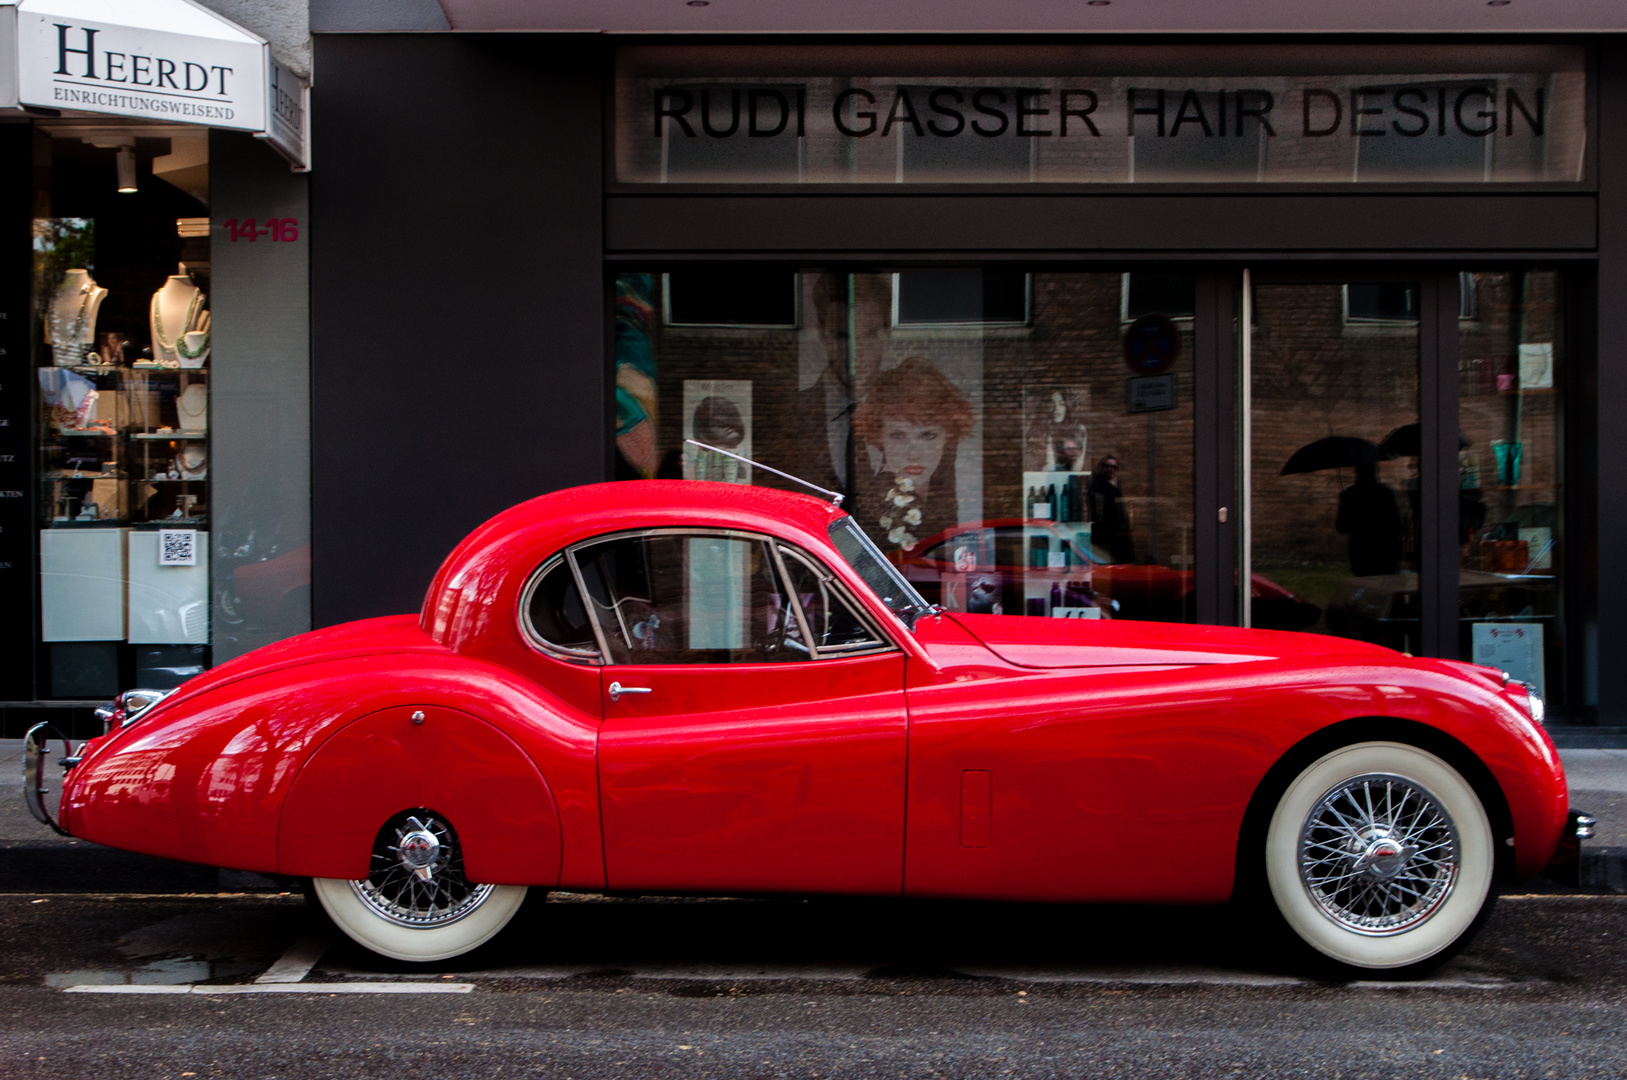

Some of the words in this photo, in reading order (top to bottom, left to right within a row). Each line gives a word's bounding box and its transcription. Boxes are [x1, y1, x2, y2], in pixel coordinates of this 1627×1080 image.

[53, 23, 234, 95] HEERDT
[53, 87, 235, 120] EINRICHTUNGSWEISEND
[654, 88, 805, 137] RUDI
[833, 87, 1100, 138] GASSER
[1128, 87, 1277, 137] HAIR
[1303, 86, 1544, 137] DESIGN
[223, 218, 298, 242] 14-16
